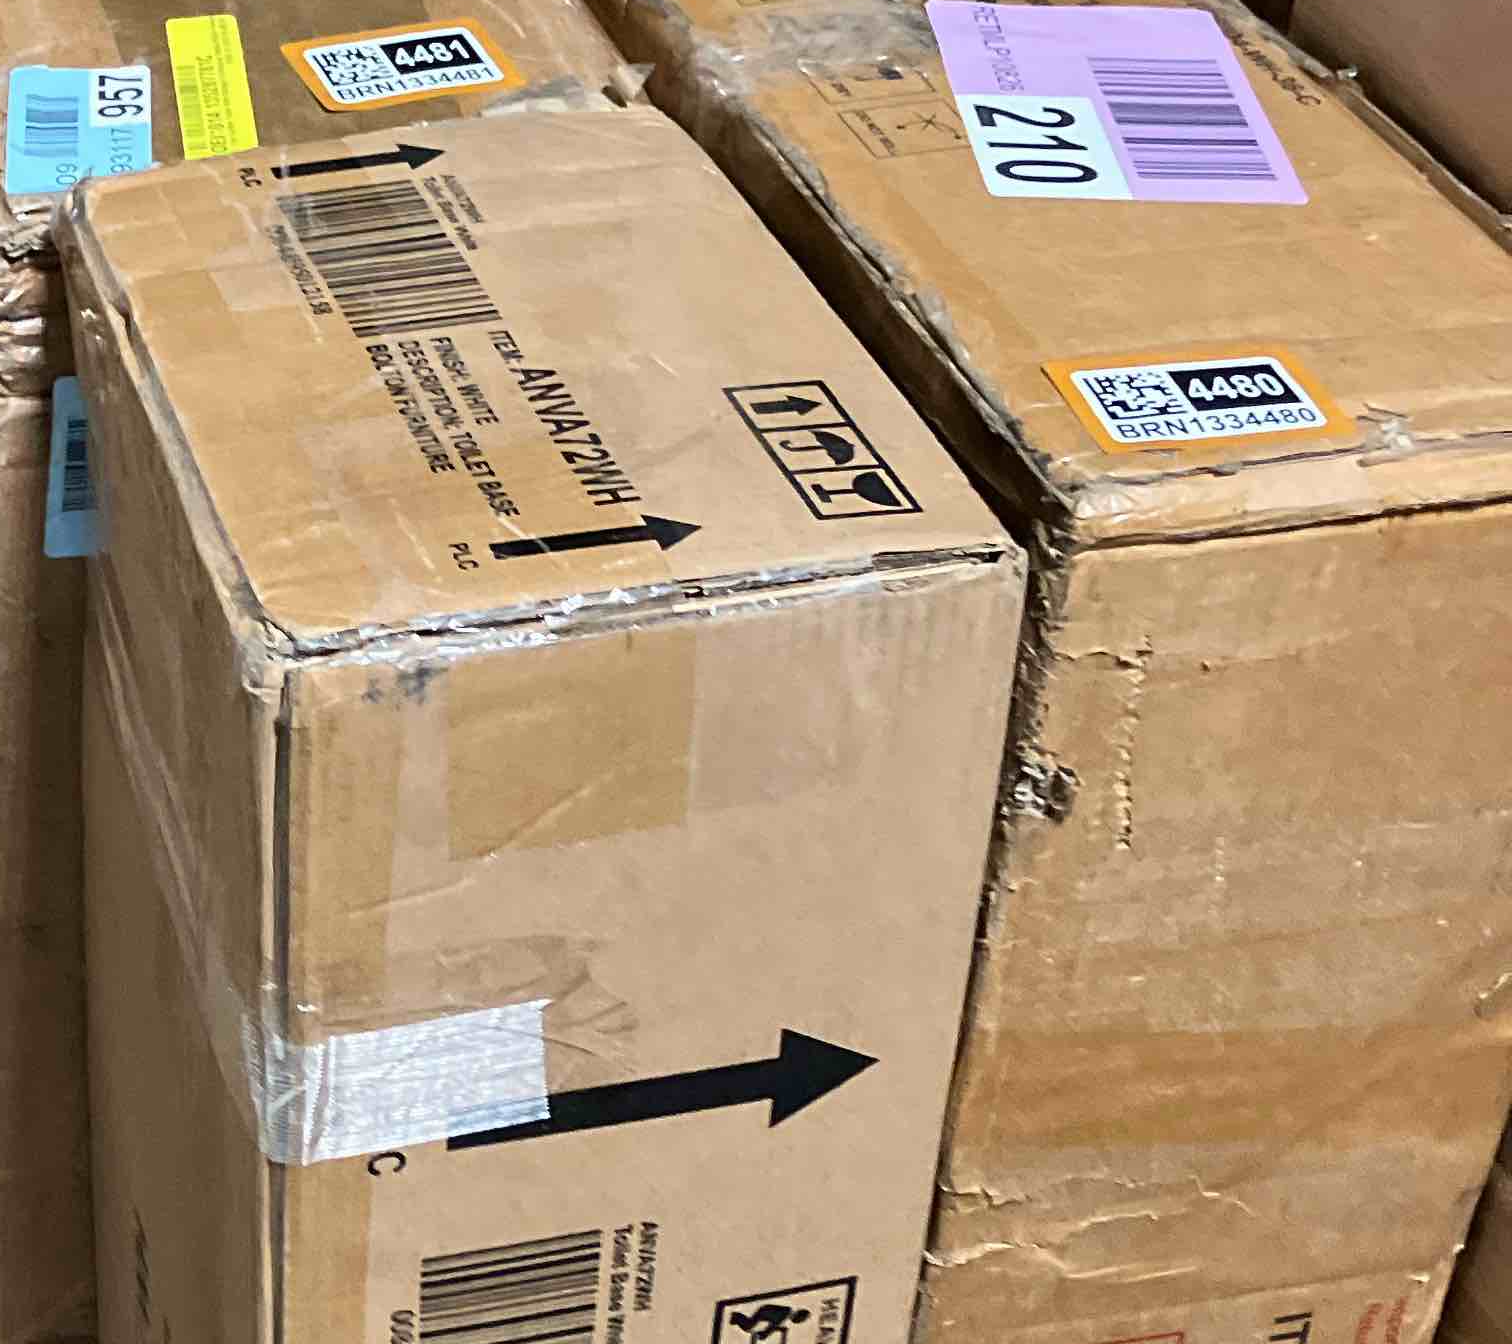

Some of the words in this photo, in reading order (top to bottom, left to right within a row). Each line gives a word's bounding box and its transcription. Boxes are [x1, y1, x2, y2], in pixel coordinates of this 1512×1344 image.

[394, 35, 468, 66] 4481
[98, 75, 143, 118] 957
[339, 64, 495, 102] BRN1334481
[972, 107, 1097, 183] 210
[366, 343, 410, 397] BOLTON
[393, 392, 456, 474] FURNITURE
[457, 383, 500, 426] WHITE
[1188, 372, 1284, 402] 4480
[518, 368, 642, 506] ANVA72WH
[1117, 407, 1317, 439] BRN1334480
[449, 431, 496, 477] TOILET
[477, 481, 521, 517] BASE
[449, 542, 479, 570] PLC
